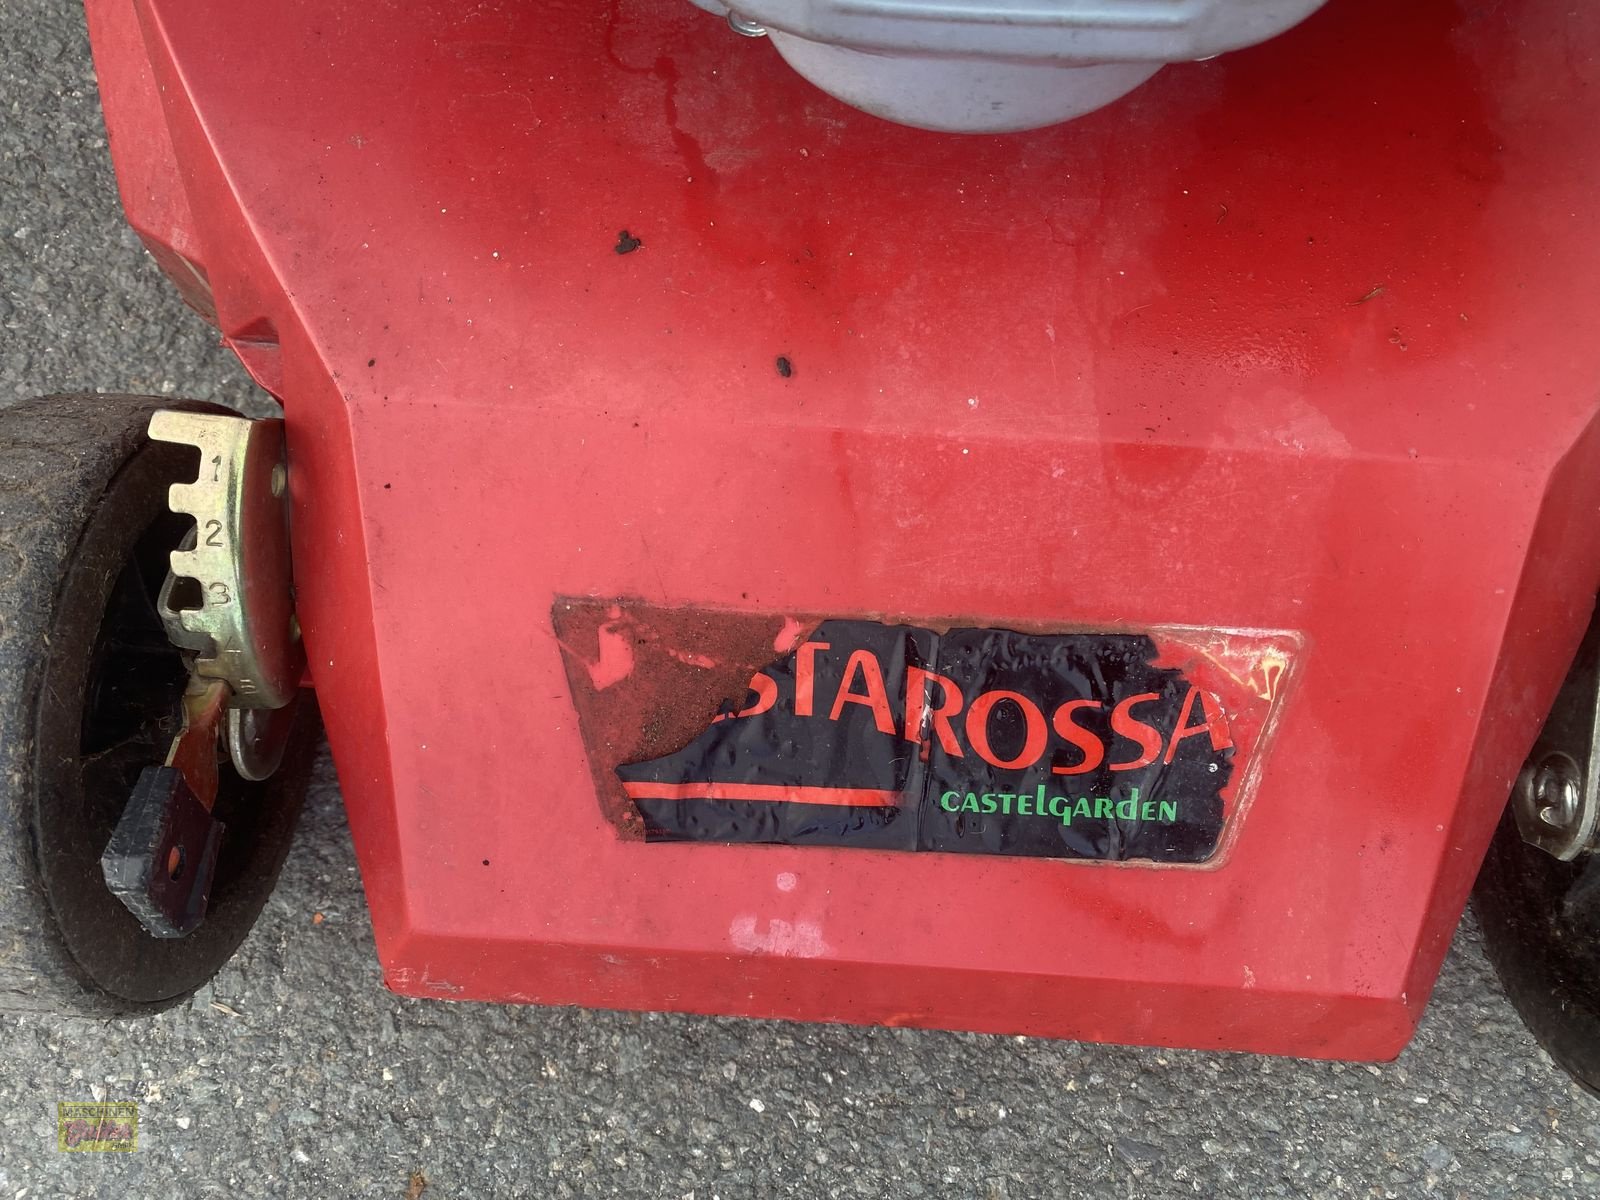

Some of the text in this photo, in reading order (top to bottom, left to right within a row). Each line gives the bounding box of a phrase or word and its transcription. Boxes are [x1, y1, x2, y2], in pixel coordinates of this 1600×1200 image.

[211, 455, 222, 482] 1
[204, 519, 224, 547] 2
[208, 581, 231, 606] 3
